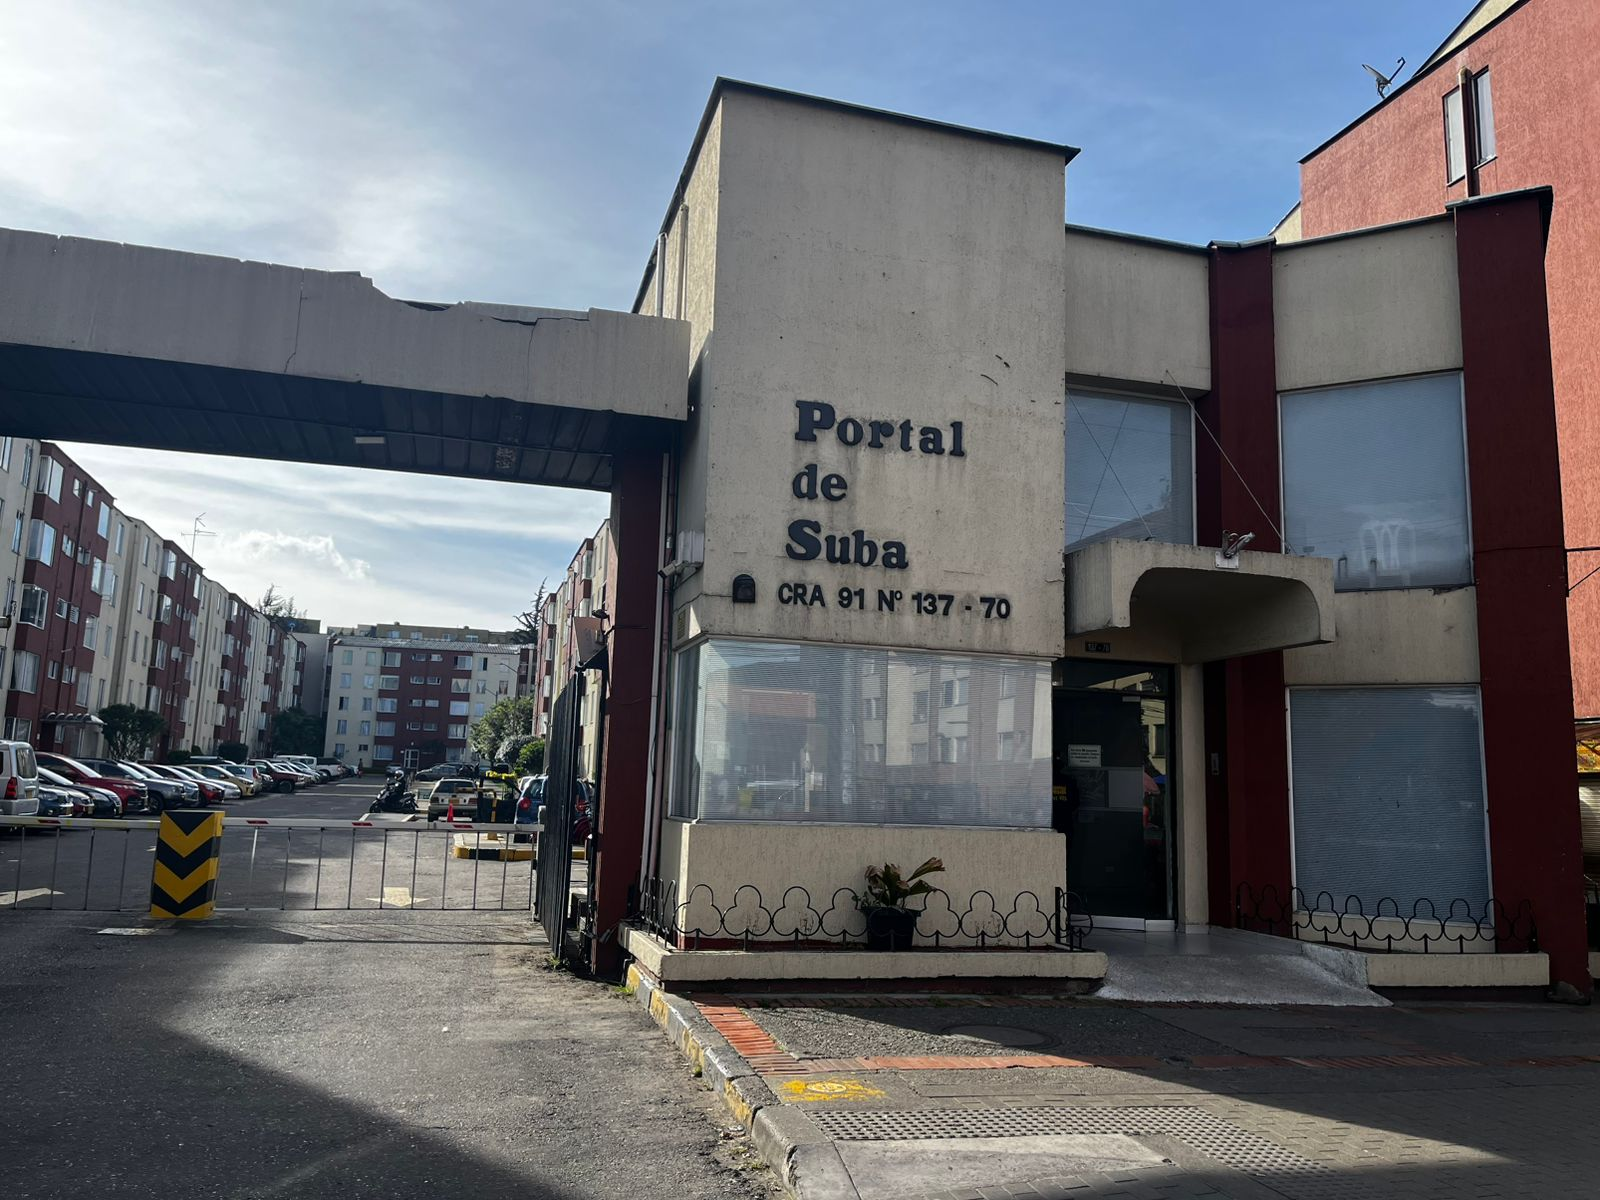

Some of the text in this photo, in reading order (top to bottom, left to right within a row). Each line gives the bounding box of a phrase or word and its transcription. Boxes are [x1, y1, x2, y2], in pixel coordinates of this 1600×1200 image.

[794, 400, 966, 457] Portal
[792, 463, 848, 502] de
[784, 518, 910, 570] Suba
[777, 582, 826, 608] CRA
[837, 586, 865, 610] 91
[911, 592, 955, 617] 137
[979, 596, 1011, 619] 70
